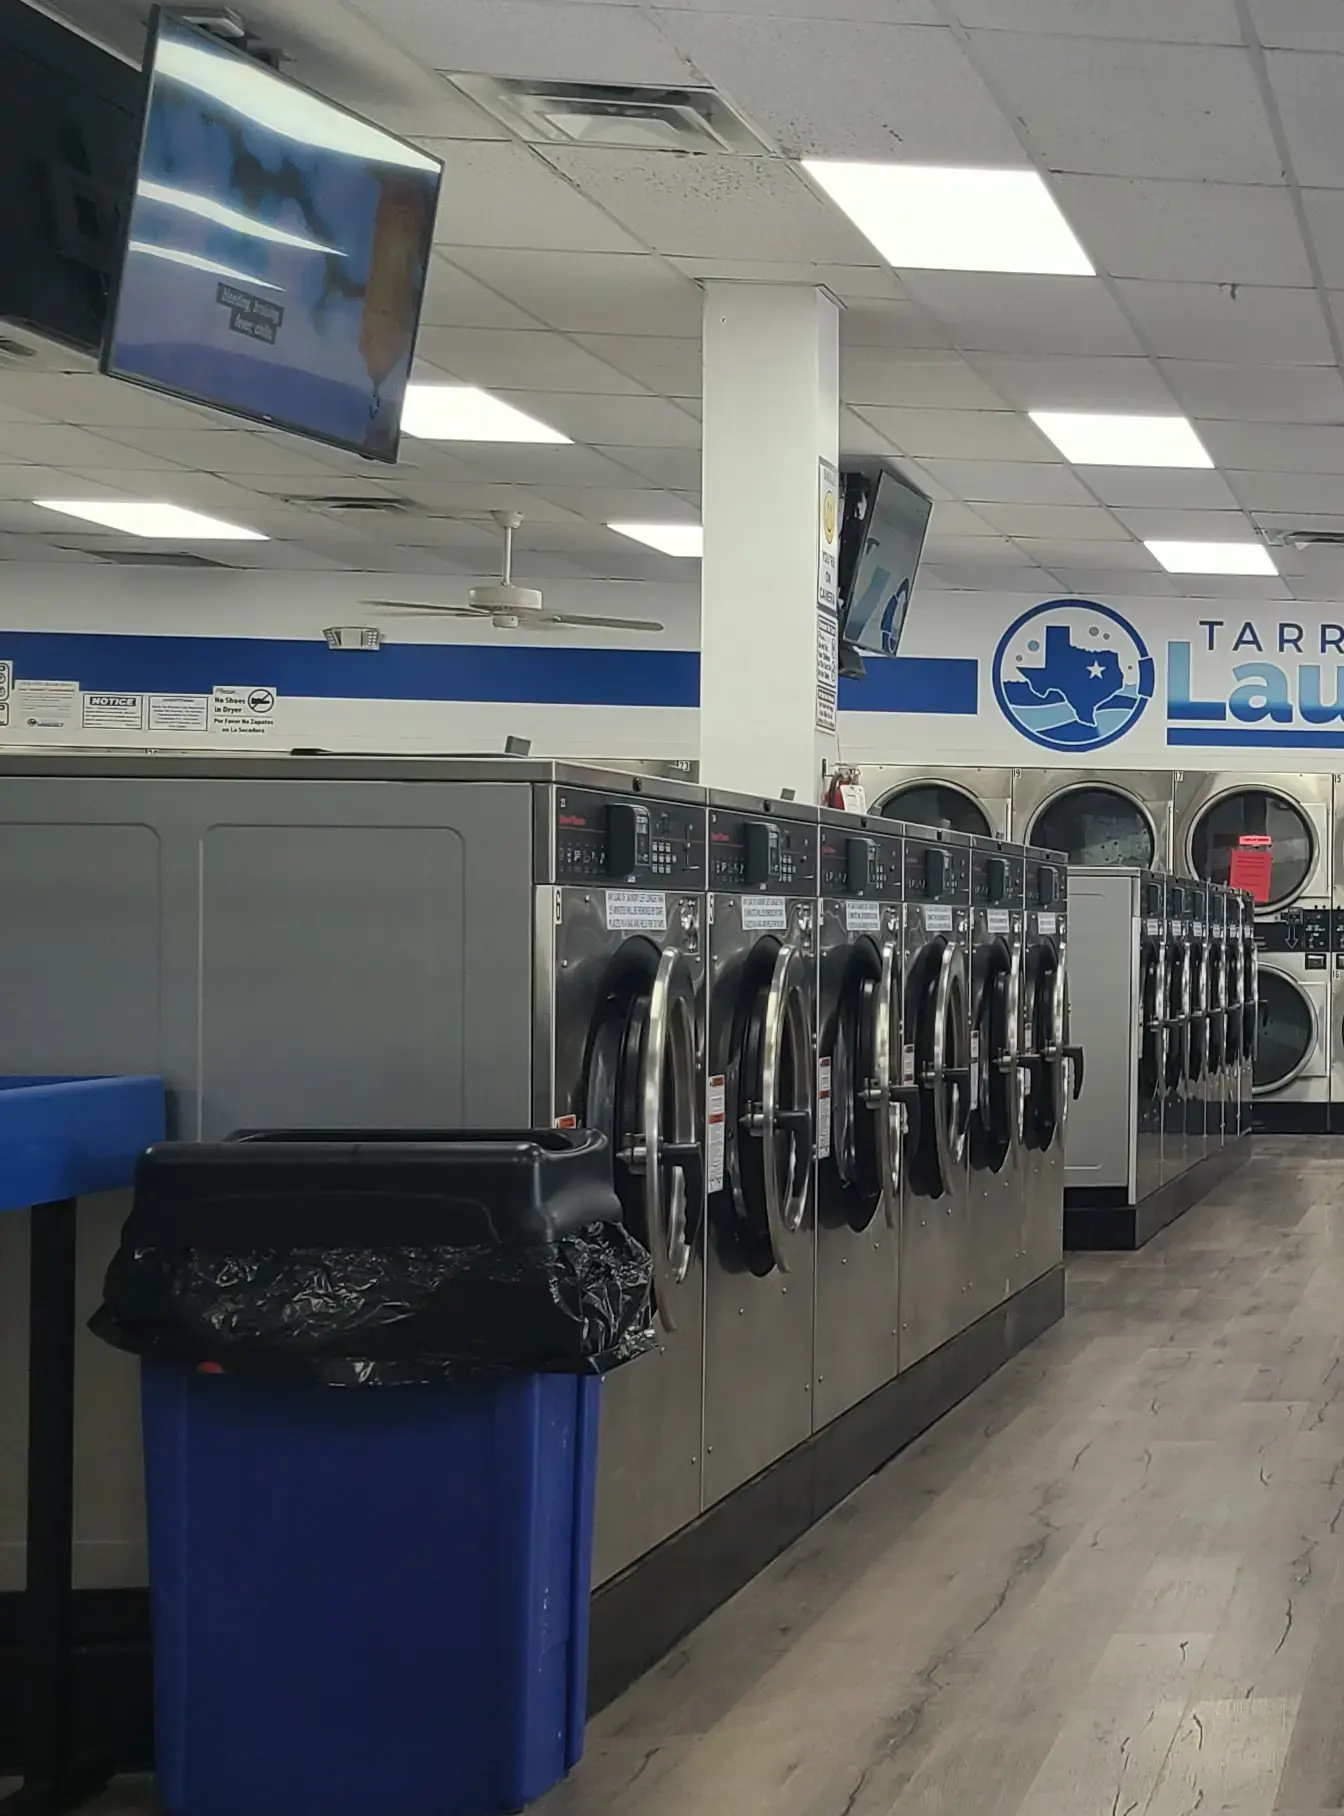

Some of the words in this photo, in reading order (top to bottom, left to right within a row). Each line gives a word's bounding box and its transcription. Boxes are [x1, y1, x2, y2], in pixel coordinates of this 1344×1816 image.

[91, 697, 135, 706] NOTICE
[225, 697, 246, 705] Shoes
[223, 706, 242, 715] Dryer
[1014, 769, 1021, 778] 19
[1175, 771, 1183, 781] 17
[1334, 774, 1342, 784] 15
[556, 889, 561, 922] 6
